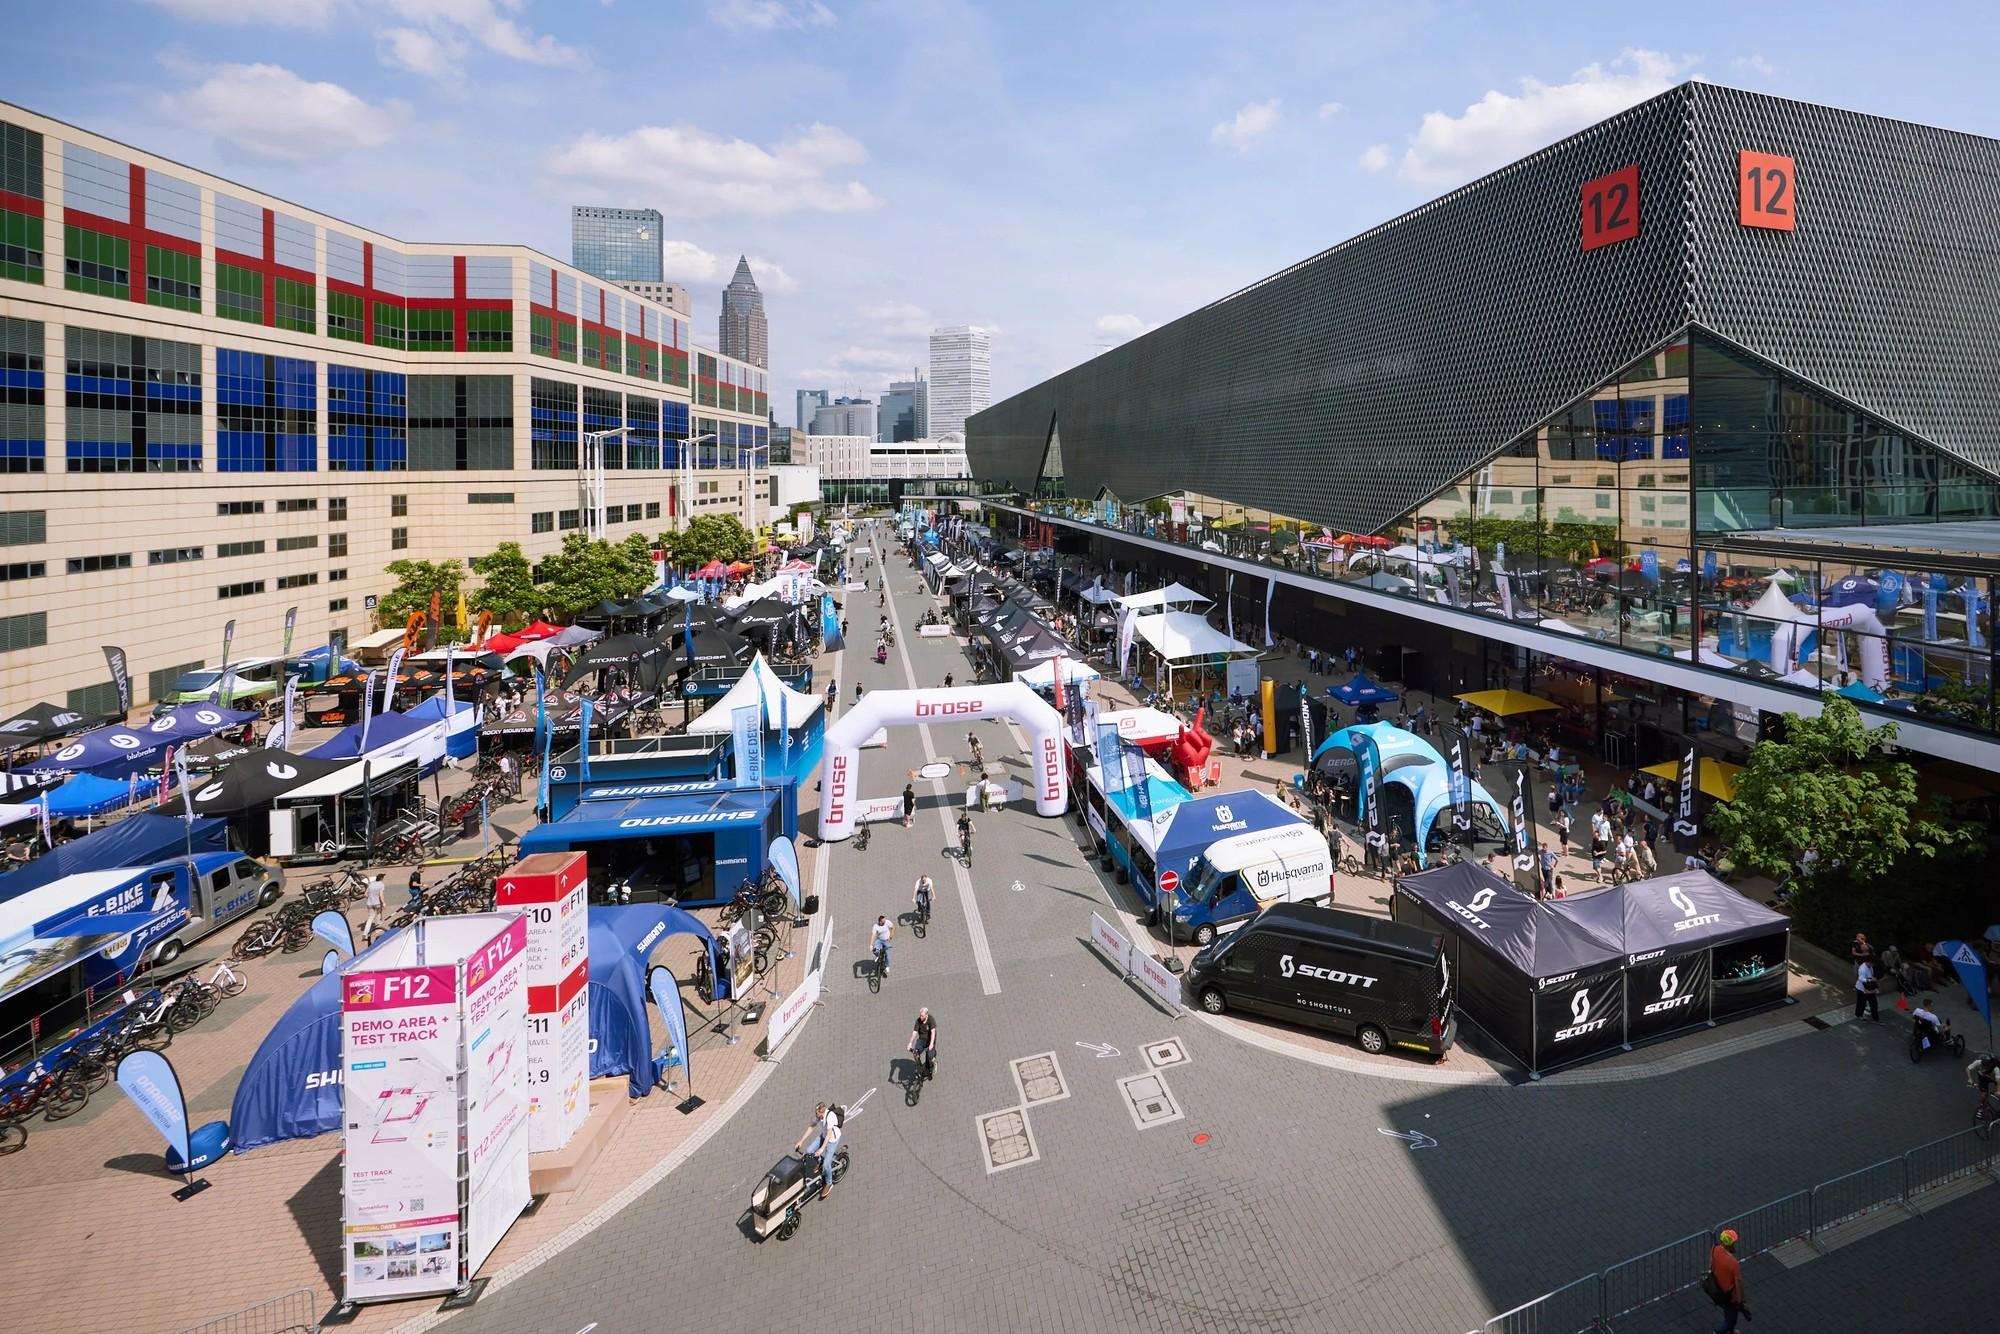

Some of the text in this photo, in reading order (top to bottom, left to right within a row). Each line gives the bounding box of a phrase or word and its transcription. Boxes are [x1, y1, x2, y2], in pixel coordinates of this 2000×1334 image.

[1748, 167, 1787, 215] 12
[1589, 183, 1629, 234] 12
[588, 656, 628, 664] STORCK
[916, 699, 983, 717] brose
[503, 728, 535, 736] MOUNTAIN
[126, 747, 157, 761] blubrake
[750, 751, 759, 782] E-BIKE
[1044, 738, 1060, 801] brose
[590, 782, 717, 797] SHIMANO
[825, 756, 847, 824] brose
[619, 811, 757, 828] SHIMANO
[1212, 820, 1247, 832] Husqvarna
[1271, 862, 1324, 883] Husqvarna
[88, 883, 144, 918] E-BIKE
[214, 890, 256, 918] E-BIKE
[571, 887, 584, 911] F11
[1402, 888, 1422, 905] SCOTT
[150, 907, 187, 935] PEGASUS
[1445, 900, 1491, 930] SCOTT
[1673, 913, 1720, 931] SCOTT
[580, 936, 585, 949] 9
[636, 921, 666, 954] SHIMANO
[1101, 926, 1120, 950] brose
[487, 933, 513, 970] F12
[1636, 950, 1666, 962] SCOTT
[1144, 961, 1167, 988] brose
[1297, 964, 1378, 988] SCOTT
[1546, 972, 1578, 985] SCOTT
[384, 975, 430, 1001] F12
[471, 986, 496, 1014] DEMO
[499, 967, 518, 991] AREA
[471, 980, 518, 1026] TEST TRACK
[572, 991, 586, 1017] F10
[1309, 1001, 1353, 1015] SHORTCUTS
[1643, 994, 1694, 1016] SCOTT
[352, 1020, 393, 1032] DEMO
[398, 1015, 437, 1028] AREA
[1554, 1018, 1607, 1042] SCOTT
[352, 1029, 438, 1045] TEST TRACK
[540, 1069, 549, 1083] 9
[473, 1136, 489, 1165] F12
[371, 1169, 393, 1177] TRACK
